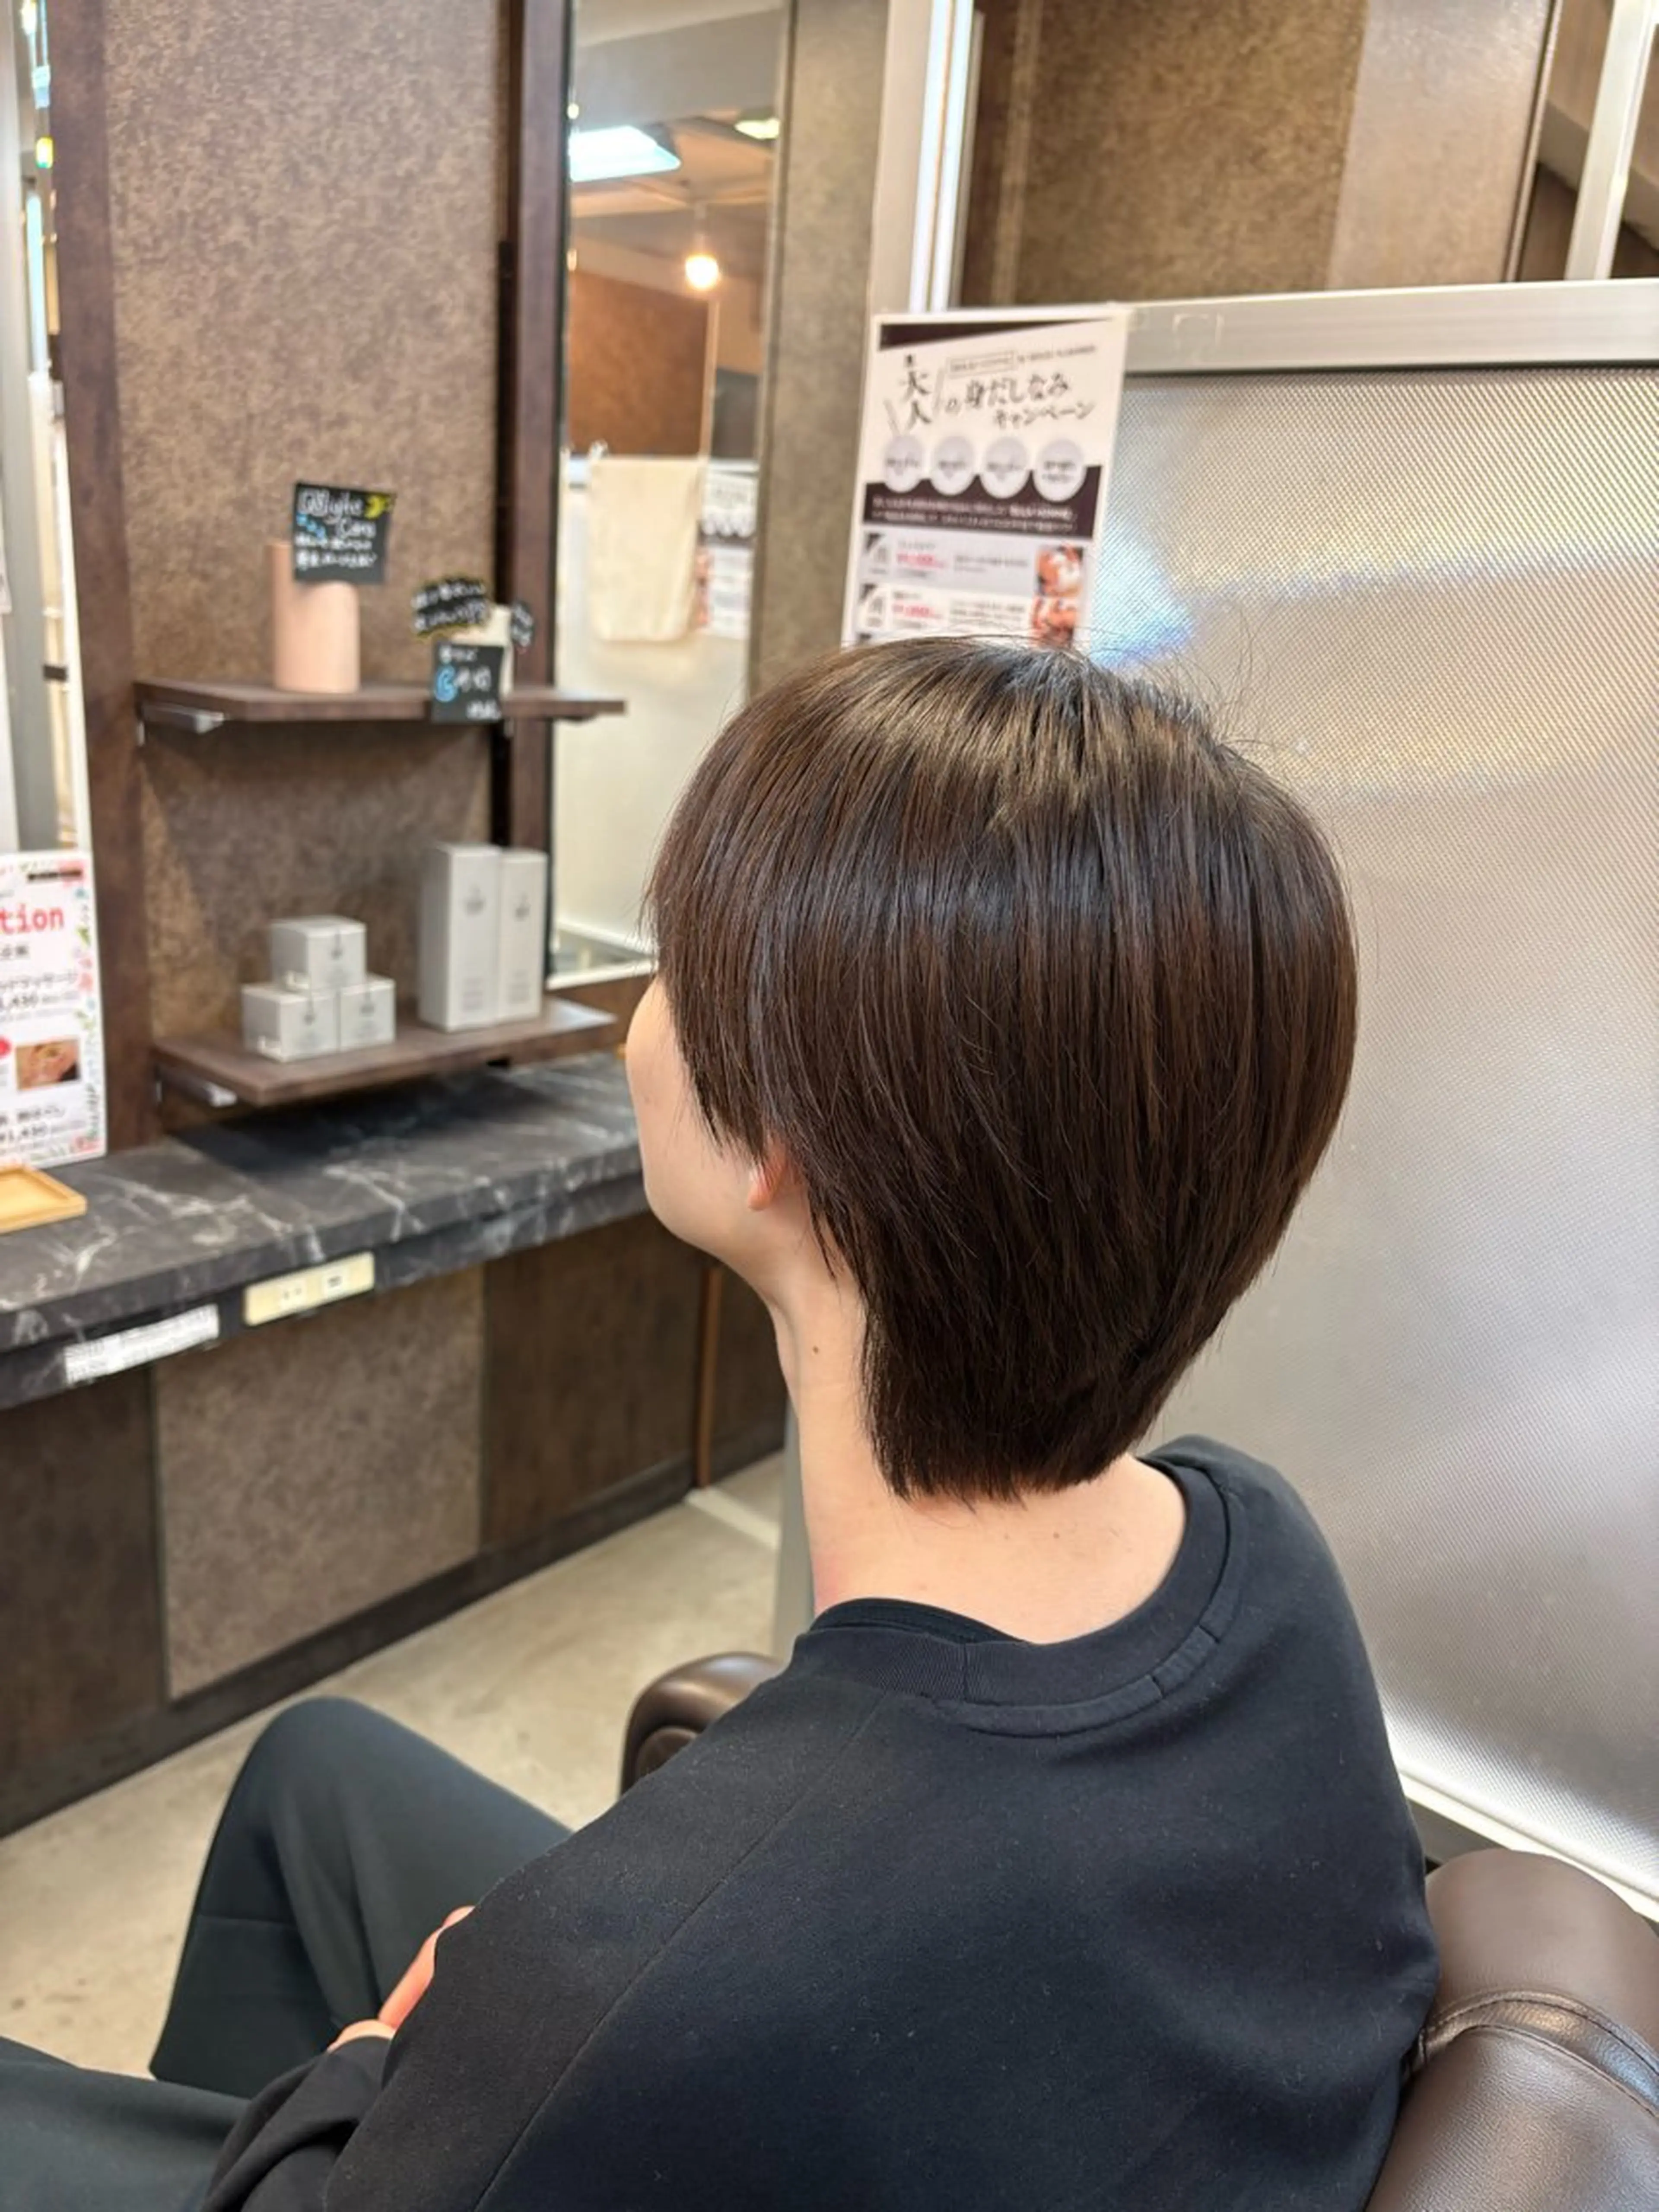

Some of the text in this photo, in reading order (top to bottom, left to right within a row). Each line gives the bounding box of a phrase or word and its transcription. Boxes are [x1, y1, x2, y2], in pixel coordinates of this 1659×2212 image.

[995, 399, 1096, 429] キャンペーン
